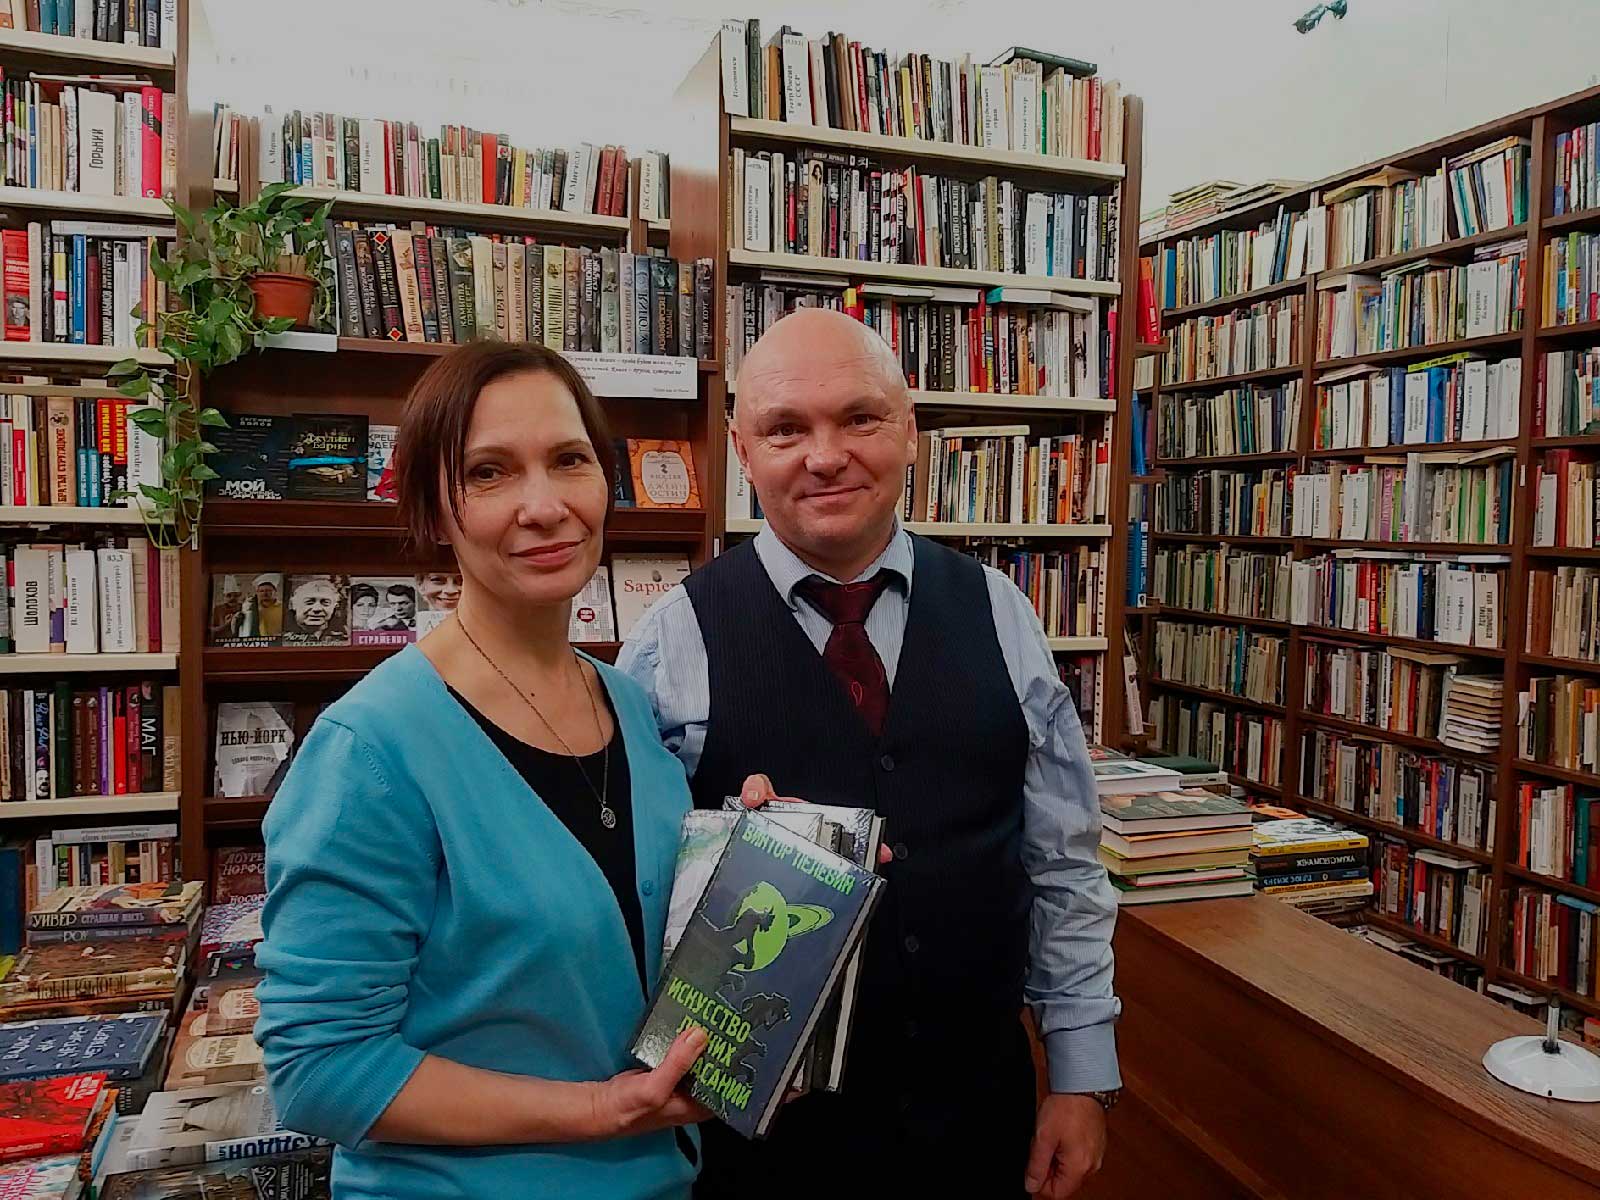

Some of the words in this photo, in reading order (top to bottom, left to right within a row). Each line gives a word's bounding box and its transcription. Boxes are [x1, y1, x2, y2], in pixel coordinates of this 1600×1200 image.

[497, 284, 505, 329] СТРАЖ
[56, 428, 66, 472] СТРУГАЦКИЕ
[57, 474, 68, 503] БРАТЬЯ
[225, 478, 266, 492] МОЙ
[141, 718, 157, 757] МАГ
[219, 726, 287, 746] НЬЮ-ЙОРК
[222, 862, 266, 876] НОРФО
[225, 852, 266, 864] ЛОУРЕ
[742, 822, 792, 860] ВИКТОР
[791, 846, 856, 896] ПЕЛЕВИН
[229, 893, 267, 904] НОСОРО
[32, 913, 77, 928] УИВЕР
[667, 976, 751, 1043] ИСКУССТВО
[690, 1056, 753, 1111] АСАНИЙ
